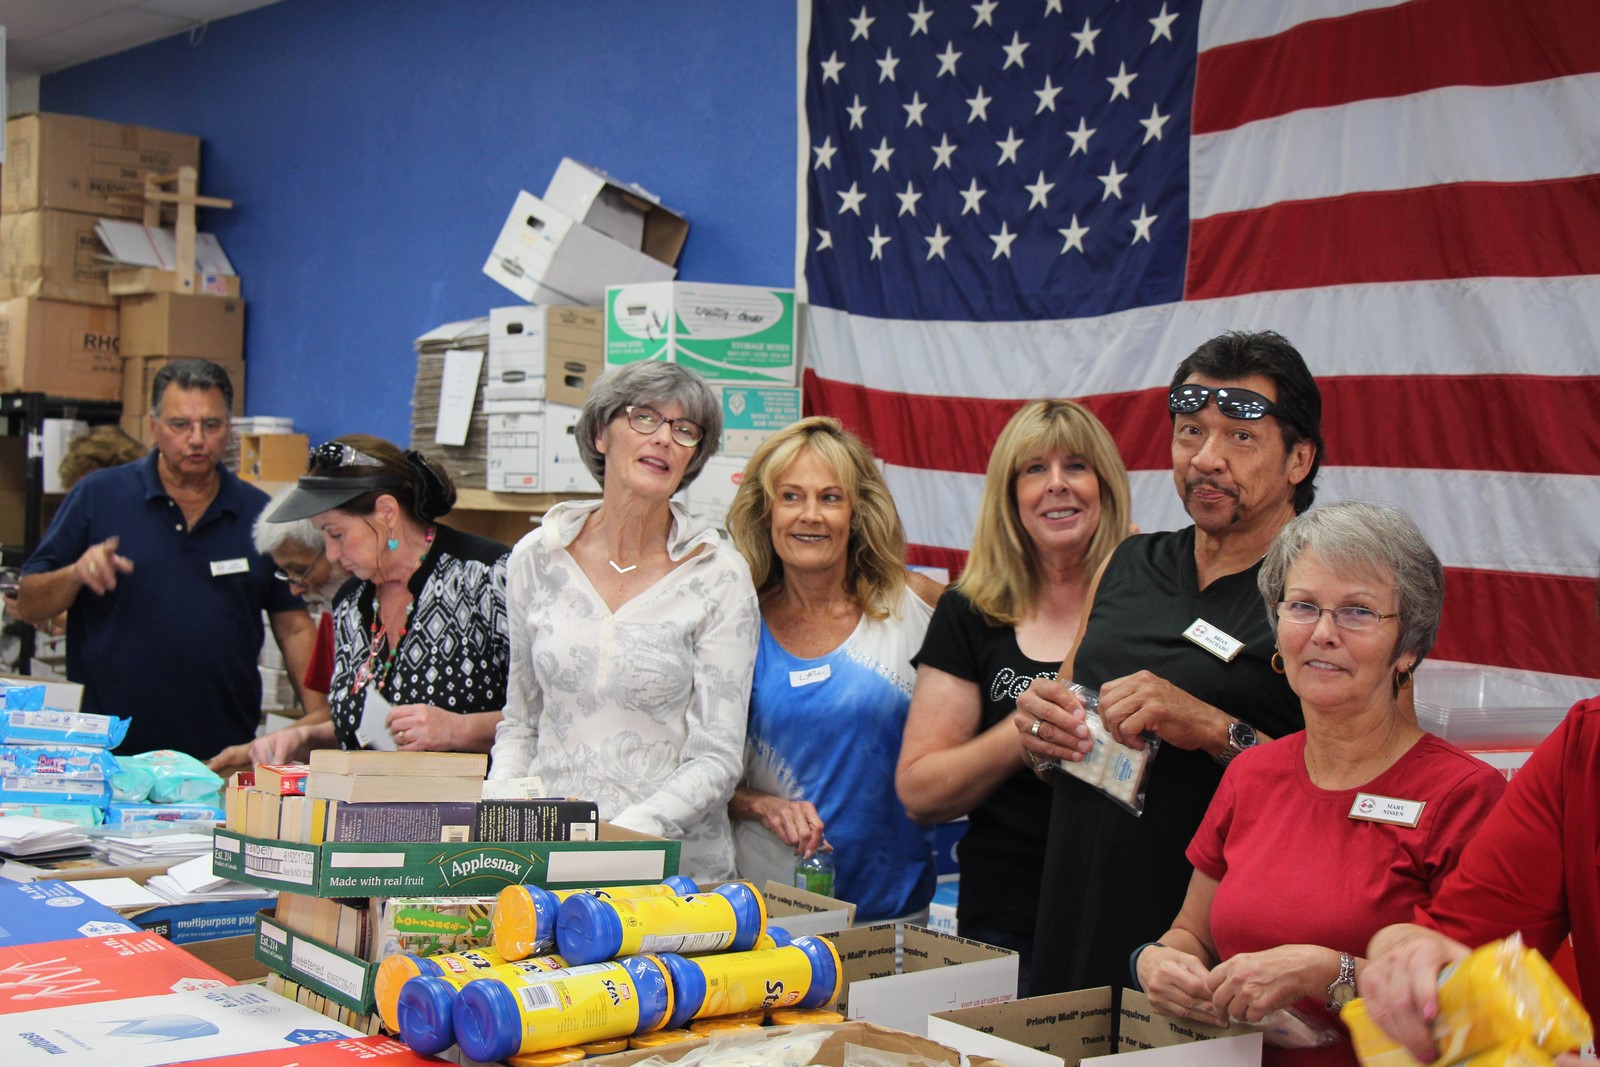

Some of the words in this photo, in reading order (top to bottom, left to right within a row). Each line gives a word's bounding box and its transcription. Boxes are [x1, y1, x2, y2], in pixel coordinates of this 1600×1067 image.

[1383, 809, 1405, 817] NISSEN
[1387, 803, 1405, 811] MARY
[452, 853, 522, 877] Applesnax
[329, 877, 357, 886] Made
[360, 876, 381, 886] with
[383, 876, 402, 886] real
[404, 875, 425, 886] fruit
[769, 893, 777, 901] for
[777, 896, 792, 907] using
[793, 899, 813, 912] Priority
[177, 916, 237, 929] multipurpose
[239, 915, 256, 926] pap
[961, 1001, 972, 1009] VISIT
[1026, 1015, 1057, 1027] Priority
[1168, 1023, 1193, 1039] Thank
[1081, 1034, 1106, 1046] Thank
[1125, 1035, 1138, 1046] for
